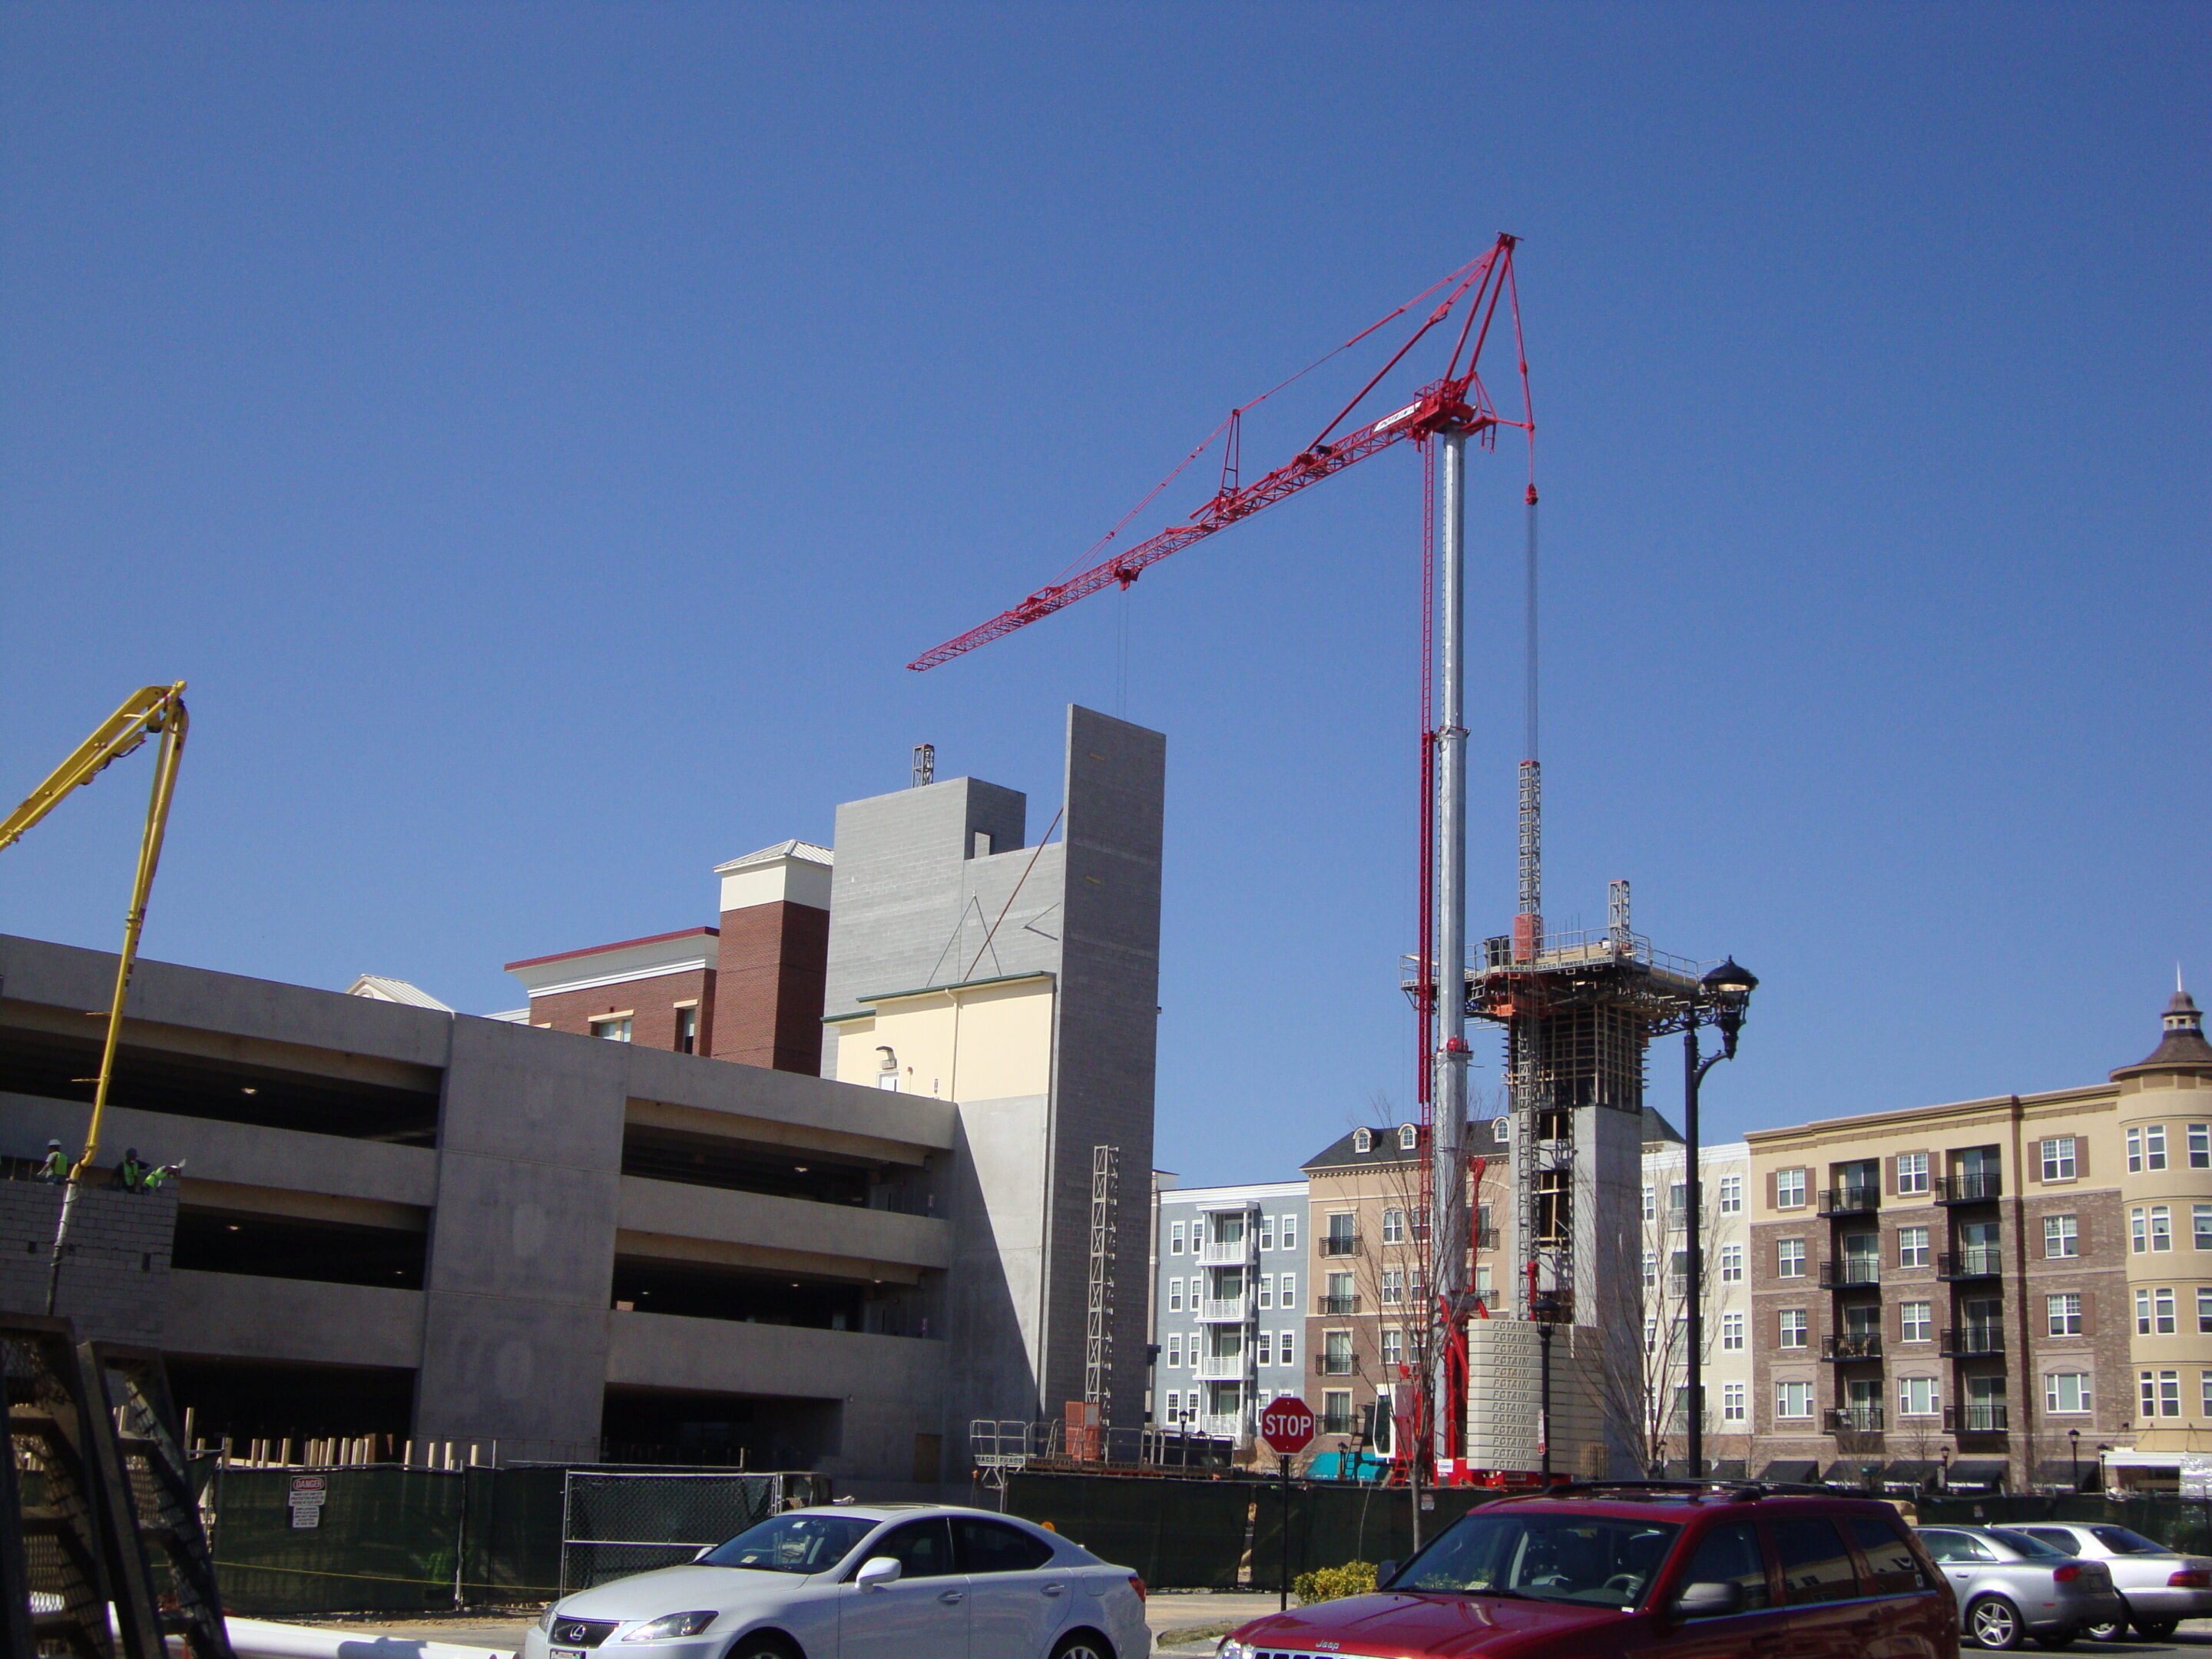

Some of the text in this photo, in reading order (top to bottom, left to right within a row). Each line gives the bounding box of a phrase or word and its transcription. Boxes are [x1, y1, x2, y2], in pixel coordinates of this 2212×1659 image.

[1493, 1321, 1529, 1331] POTAIN
[1493, 1333, 1529, 1343] POTAIN
[1493, 1344, 1529, 1354] POTAIN
[1493, 1356, 1529, 1366] POTAIN
[1493, 1367, 1529, 1377] POTAIN
[1493, 1379, 1529, 1389] POTAIN
[1493, 1390, 1529, 1400] POTAIN
[1493, 1402, 1529, 1412] POTAIN
[1493, 1414, 1529, 1423] POTAIN
[1265, 1414, 1311, 1436] STOP
[1493, 1425, 1529, 1435] POTAIN
[1493, 1436, 1529, 1447] POTAIN
[1493, 1449, 1529, 1459] POTAIN
[1493, 1460, 1529, 1470] POTAIN
[296, 1479, 322, 1488] DANGER
[1315, 1640, 1339, 1651] Jeep
